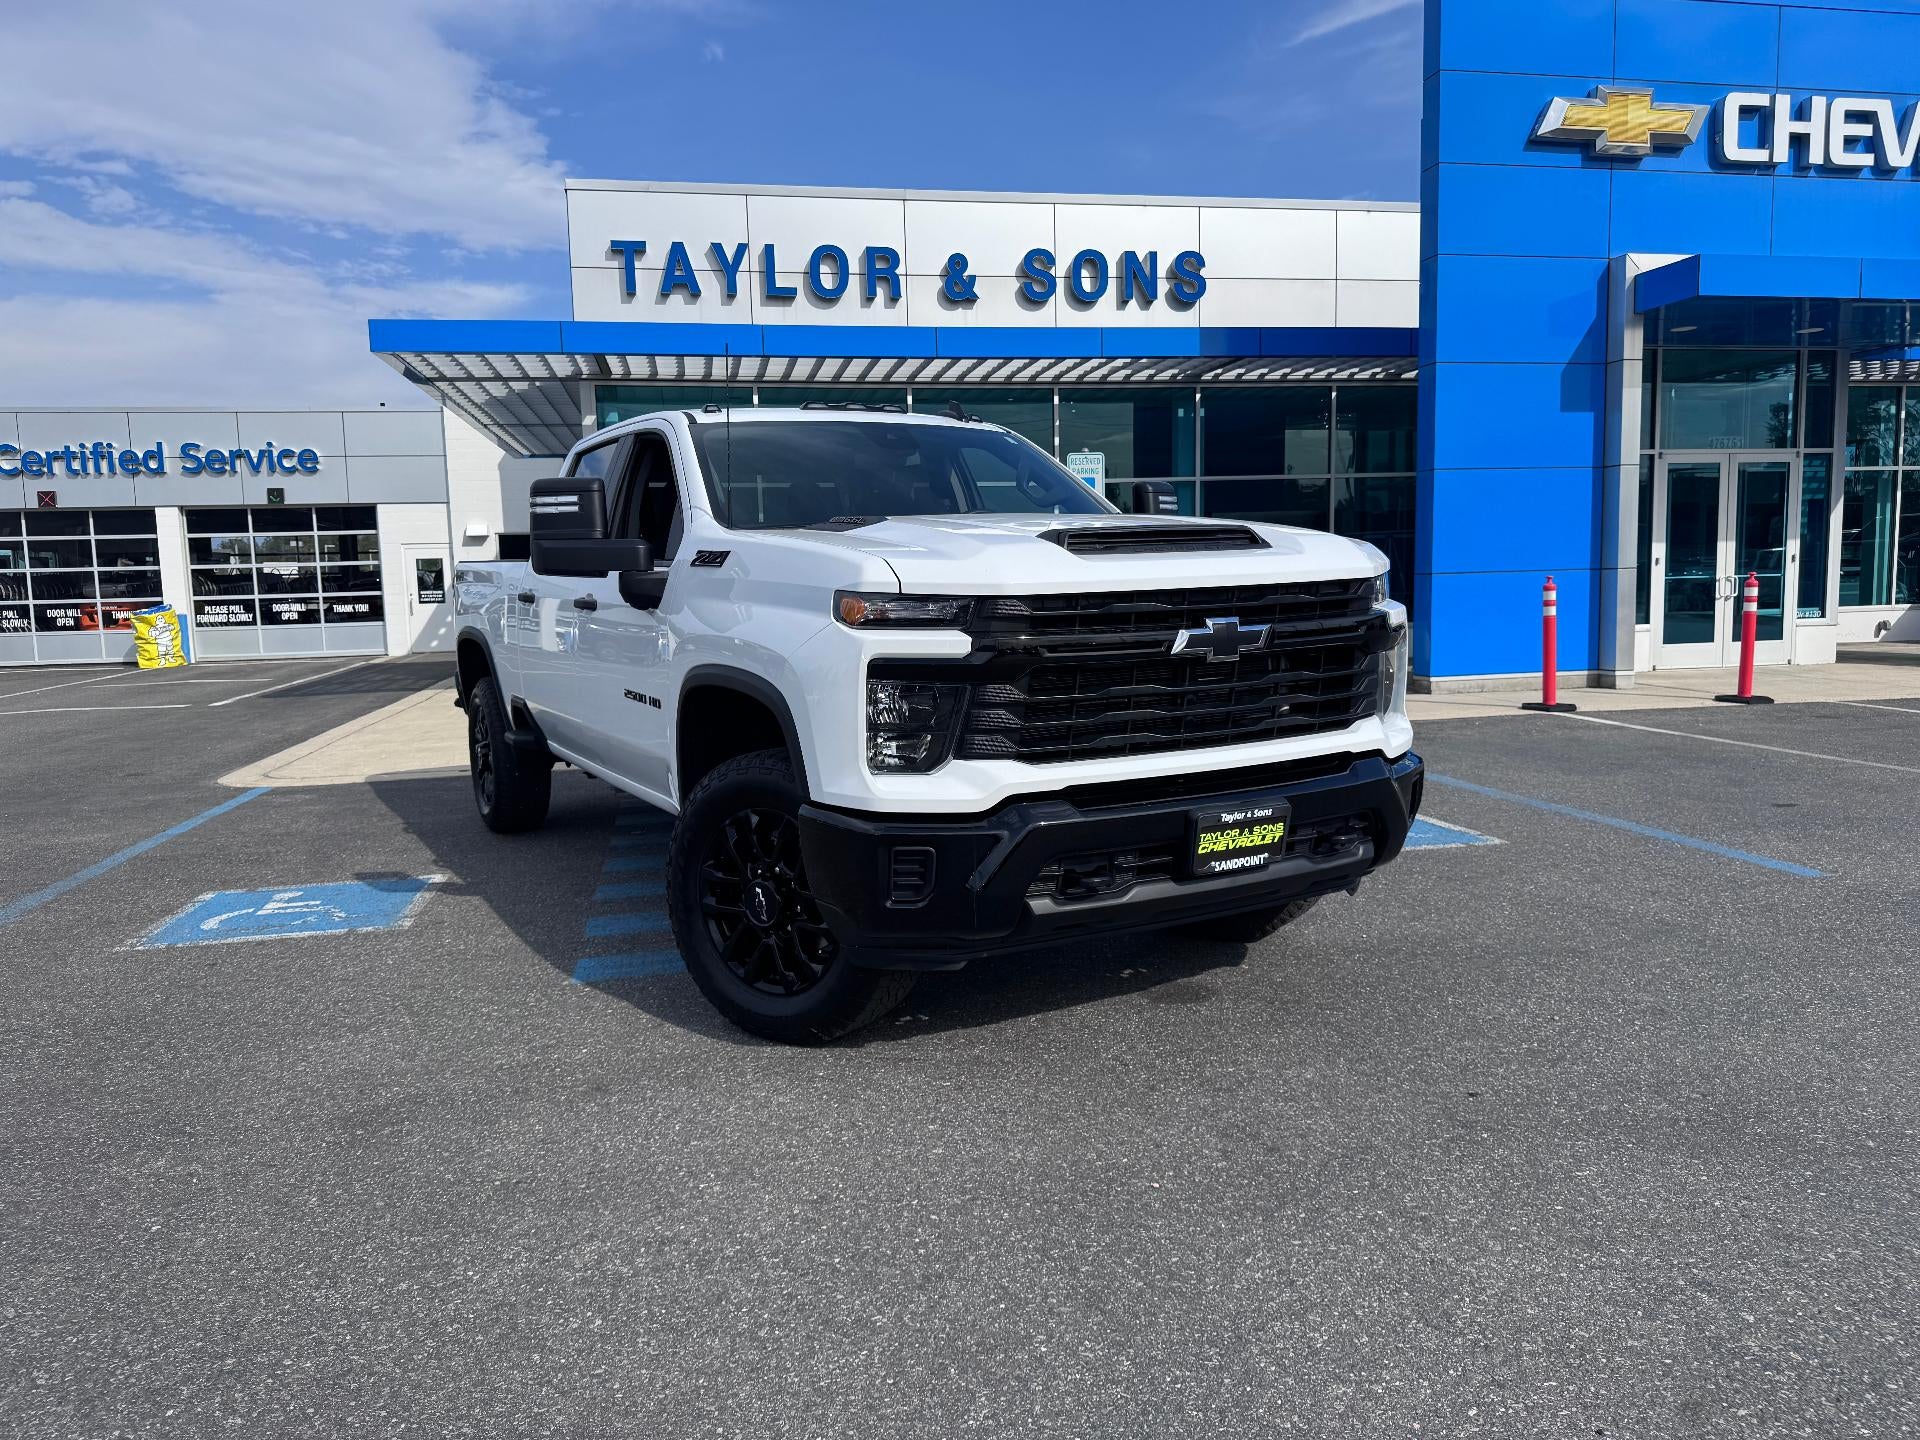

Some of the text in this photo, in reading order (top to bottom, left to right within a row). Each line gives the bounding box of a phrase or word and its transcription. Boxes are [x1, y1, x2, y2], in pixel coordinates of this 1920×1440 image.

[1724, 92, 1920, 167] CHEV
[610, 240, 1207, 302] TAYLOR & SONS
[0, 441, 319, 475] Certified Service
[1071, 457, 1101, 466] RESERVED
[1072, 467, 1100, 475] PARKING
[204, 605, 246, 614] PLEASE PULL
[272, 603, 306, 612] DOOR WILL
[333, 603, 369, 613] THANK YOU!
[2, 610, 19, 618] PULL
[46, 608, 82, 618] DOOR WILL
[196, 613, 253, 623] FORWARD SLOWLY
[281, 612, 299, 620] OPEN
[2, 619, 28, 628] SLOWLY
[56, 618, 75, 627] OPEN
[623, 688, 662, 710] 2500 HD
[1221, 812, 1246, 824] Taylor
[1253, 808, 1273, 818] Sons
[1200, 822, 1284, 843] TAYLOR & SONS
[1197, 832, 1284, 854] CHEVROLET
